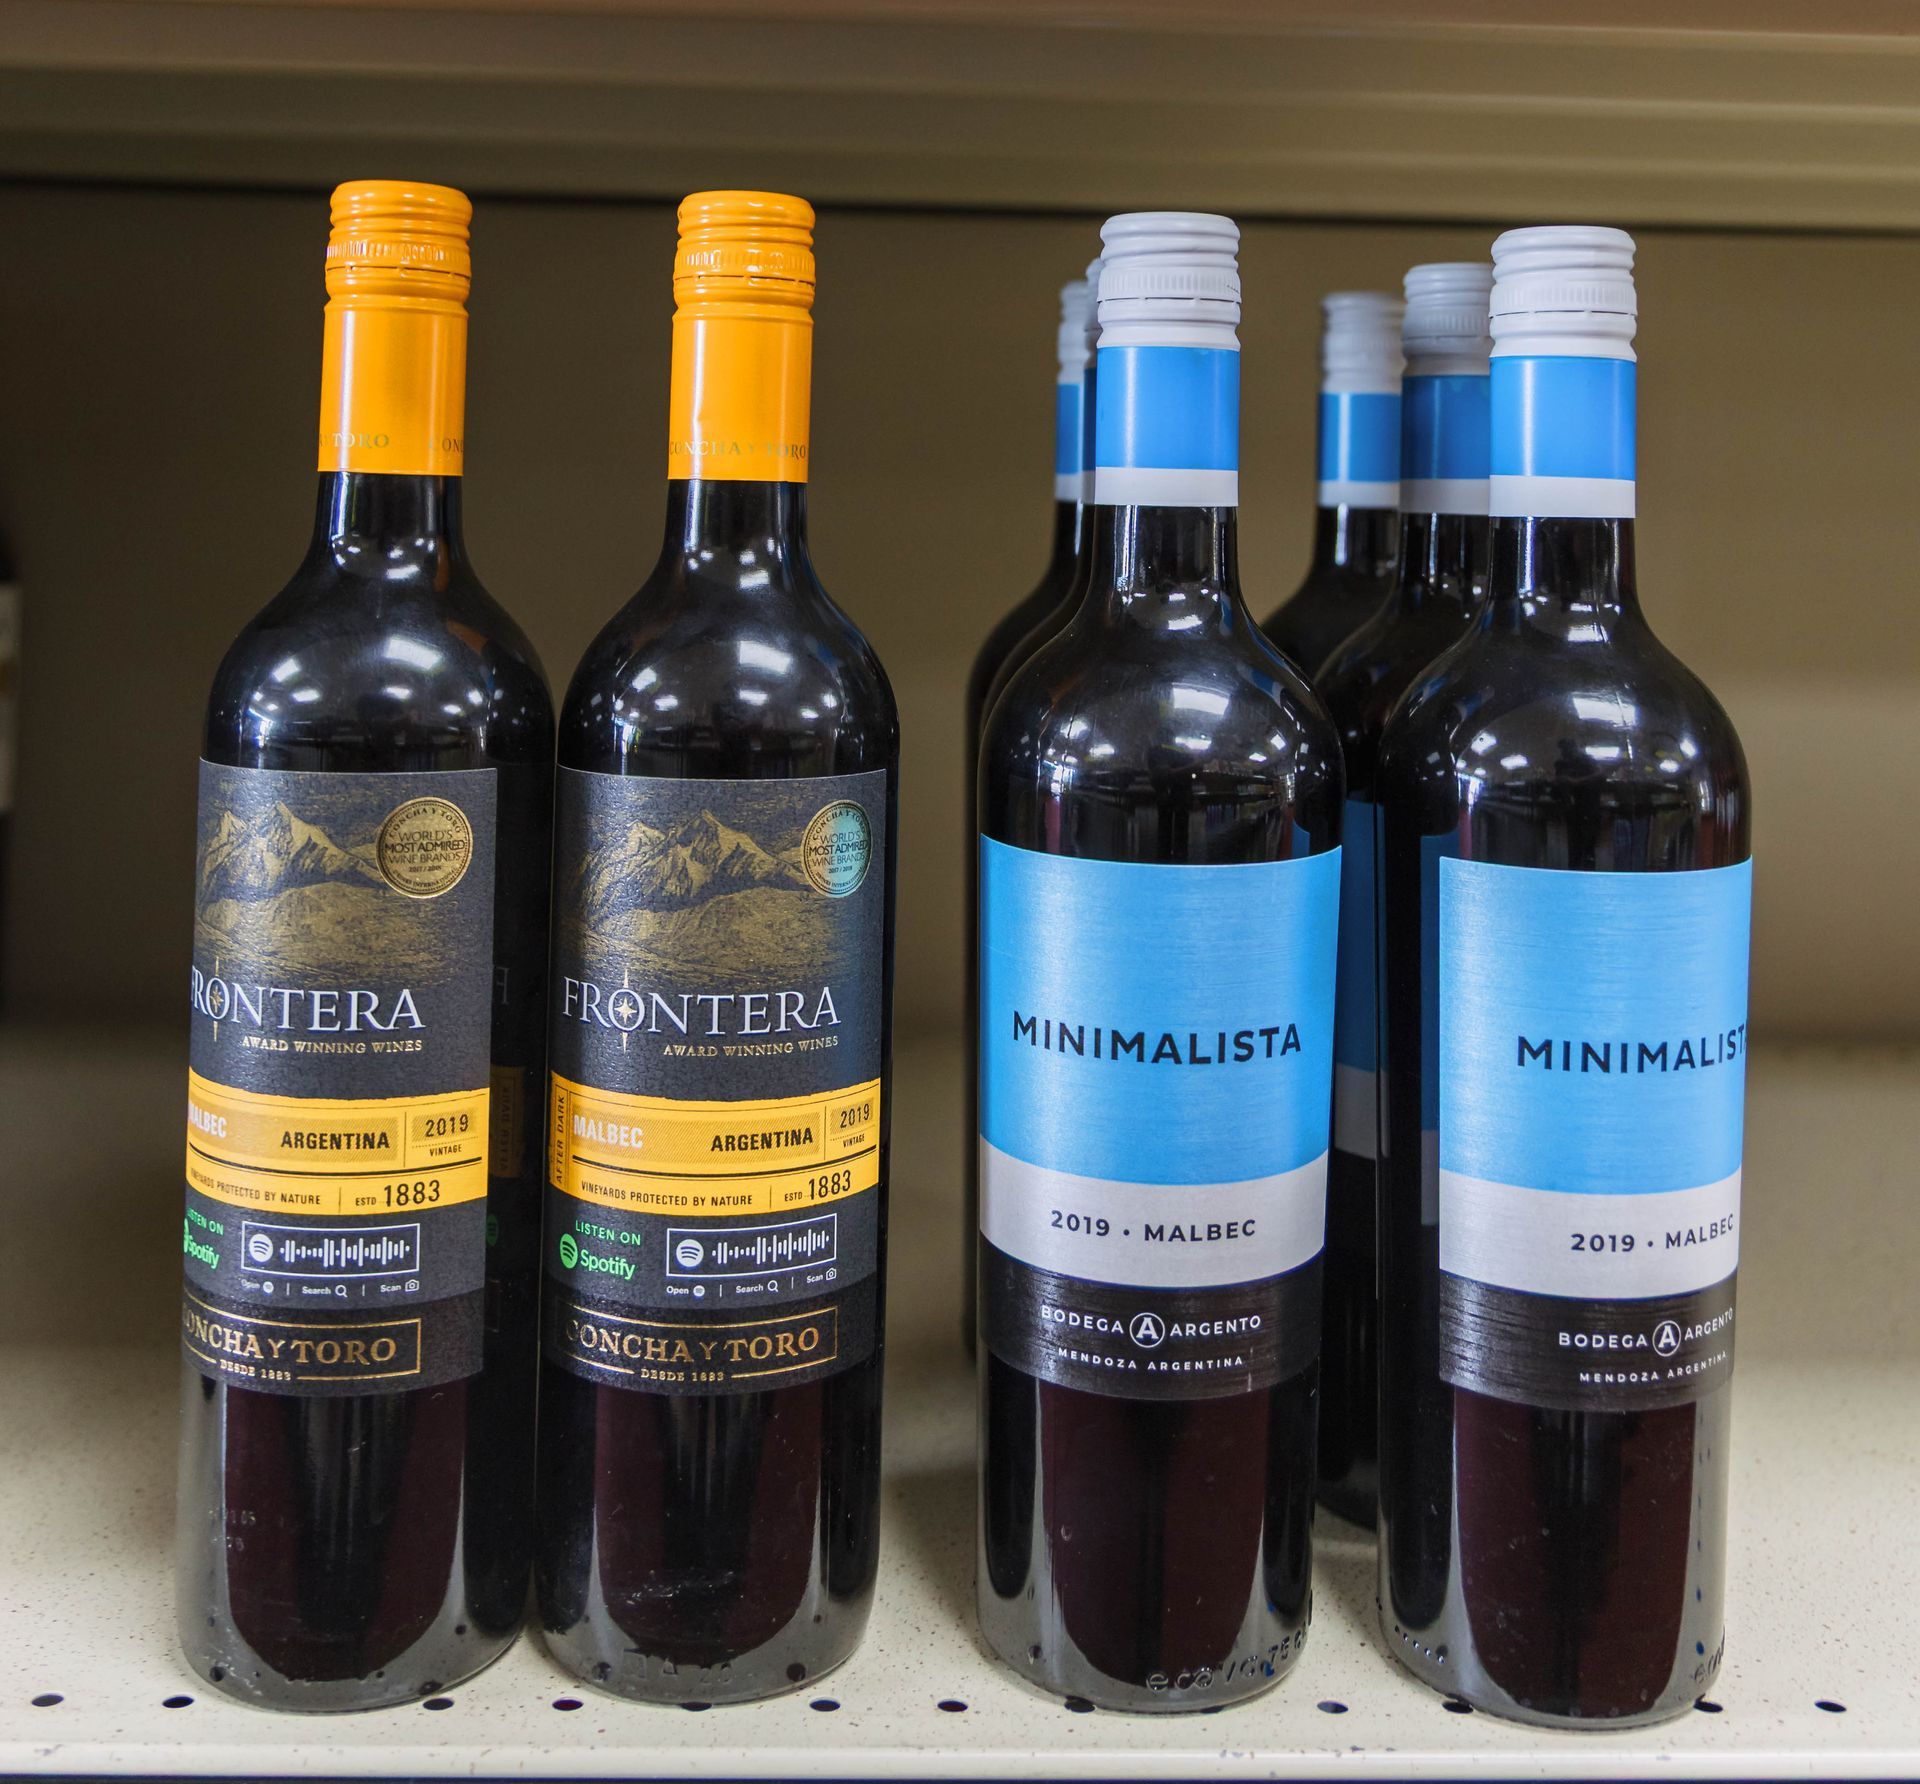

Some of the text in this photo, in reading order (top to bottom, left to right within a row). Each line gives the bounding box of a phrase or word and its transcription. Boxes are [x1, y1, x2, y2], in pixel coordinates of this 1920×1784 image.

[388, 807, 428, 838] CONCHA
[440, 810, 462, 834] TORO
[398, 829, 453, 842] WORLD'S
[812, 809, 843, 841] CONCHA
[385, 839, 466, 854] MOST ADMIRED
[388, 851, 461, 864] WINE BRANDS
[808, 840, 868, 856] MOST ADMIRED
[811, 851, 865, 867] WINE BRANDS
[562, 976, 842, 1035] FRONTERA
[242, 1036, 422, 1054] AWARD WINNING WINES
[663, 1035, 839, 1057] AWARD WINNING WINES
[1013, 1010, 1302, 1065] MINIMALISTA
[1517, 1023, 1746, 1074] MINIMALIST
[424, 1113, 469, 1138] 2019
[557, 1095, 565, 1133] DARK
[840, 1102, 870, 1130] 2019
[280, 1131, 390, 1151] ARGENTINA
[573, 1115, 643, 1150] MALBEC
[710, 1127, 813, 1152] ARGENTINA
[843, 1133, 866, 1149] VINTAGE
[428, 1143, 463, 1157] VINTAGE
[216, 1180, 261, 1200] PROTECTED
[264, 1191, 278, 1202] BY
[280, 1193, 321, 1206] NATURE
[355, 1179, 441, 1208] ESTD 1883
[581, 1180, 753, 1206] VINEYARDS PROTECTED BY NATURE
[784, 1169, 851, 1203] ESTD 1883
[209, 1220, 224, 1236] ON
[575, 1220, 641, 1246] LISTEN ON
[1050, 1209, 1256, 1242] 2019 MALBEC
[1570, 1213, 1734, 1252] 2019 MALBEC
[580, 1249, 637, 1281] Spotify
[302, 1286, 331, 1296] Search
[380, 1282, 402, 1293] Scan
[666, 1286, 689, 1297] Open
[736, 1283, 763, 1294] Search
[806, 1273, 823, 1284] Scan
[1041, 1305, 1124, 1335] BODEGA
[1169, 1314, 1262, 1337] ARGENTO
[1558, 1332, 1648, 1349] BODEGA
[1684, 1307, 1734, 1342] ARGENTO
[268, 1338, 286, 1358] Y
[290, 1337, 397, 1366] TORO
[566, 1319, 819, 1363] CONCHA Y TORO
[1058, 1347, 1244, 1372] MENDOZA ARGENTINA
[1579, 1351, 1728, 1384] MENDOZA ARGENTINA
[641, 1368, 685, 1382] DESDE
